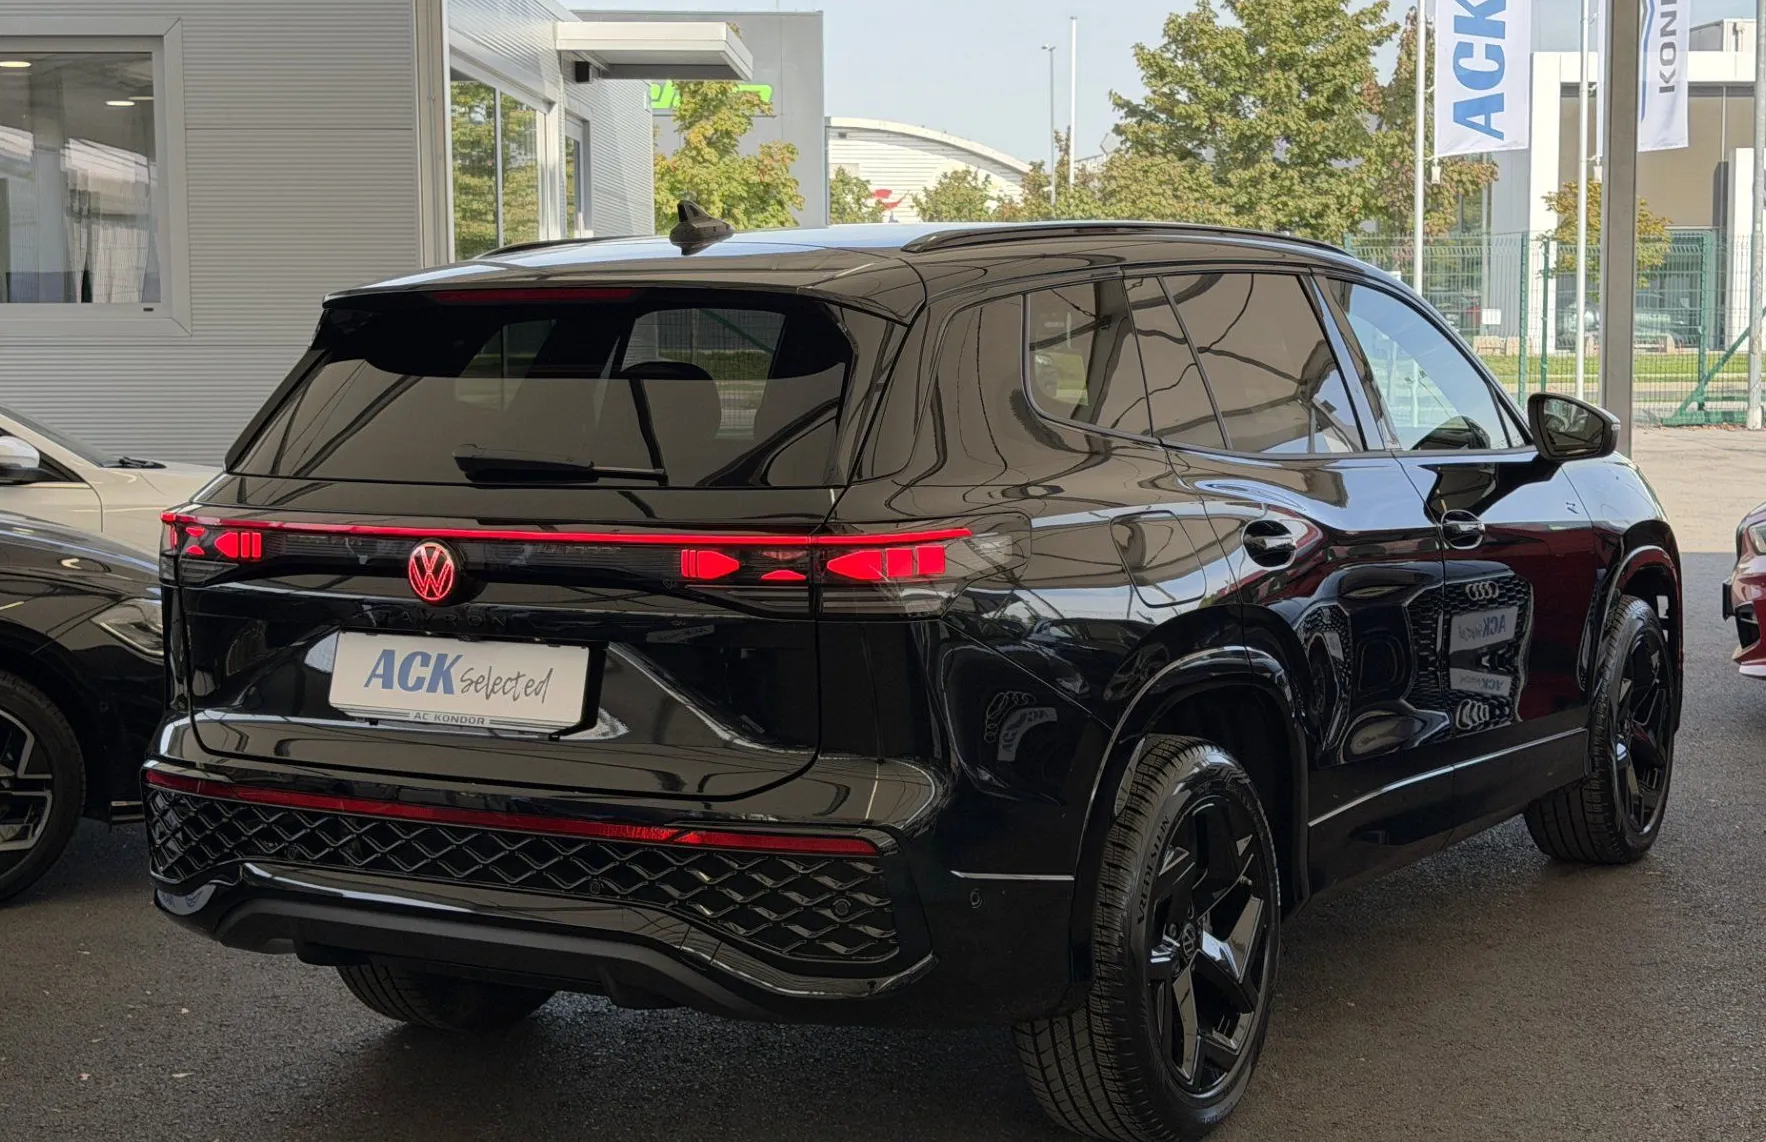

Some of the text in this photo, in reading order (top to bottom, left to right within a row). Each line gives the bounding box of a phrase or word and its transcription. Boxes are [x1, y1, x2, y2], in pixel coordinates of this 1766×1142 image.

[1453, 0, 1506, 141] ACK
[1659, 0, 1677, 93] KON
[364, 649, 554, 704] ACK Selected
[413, 712, 485, 726] AC KONDOR
